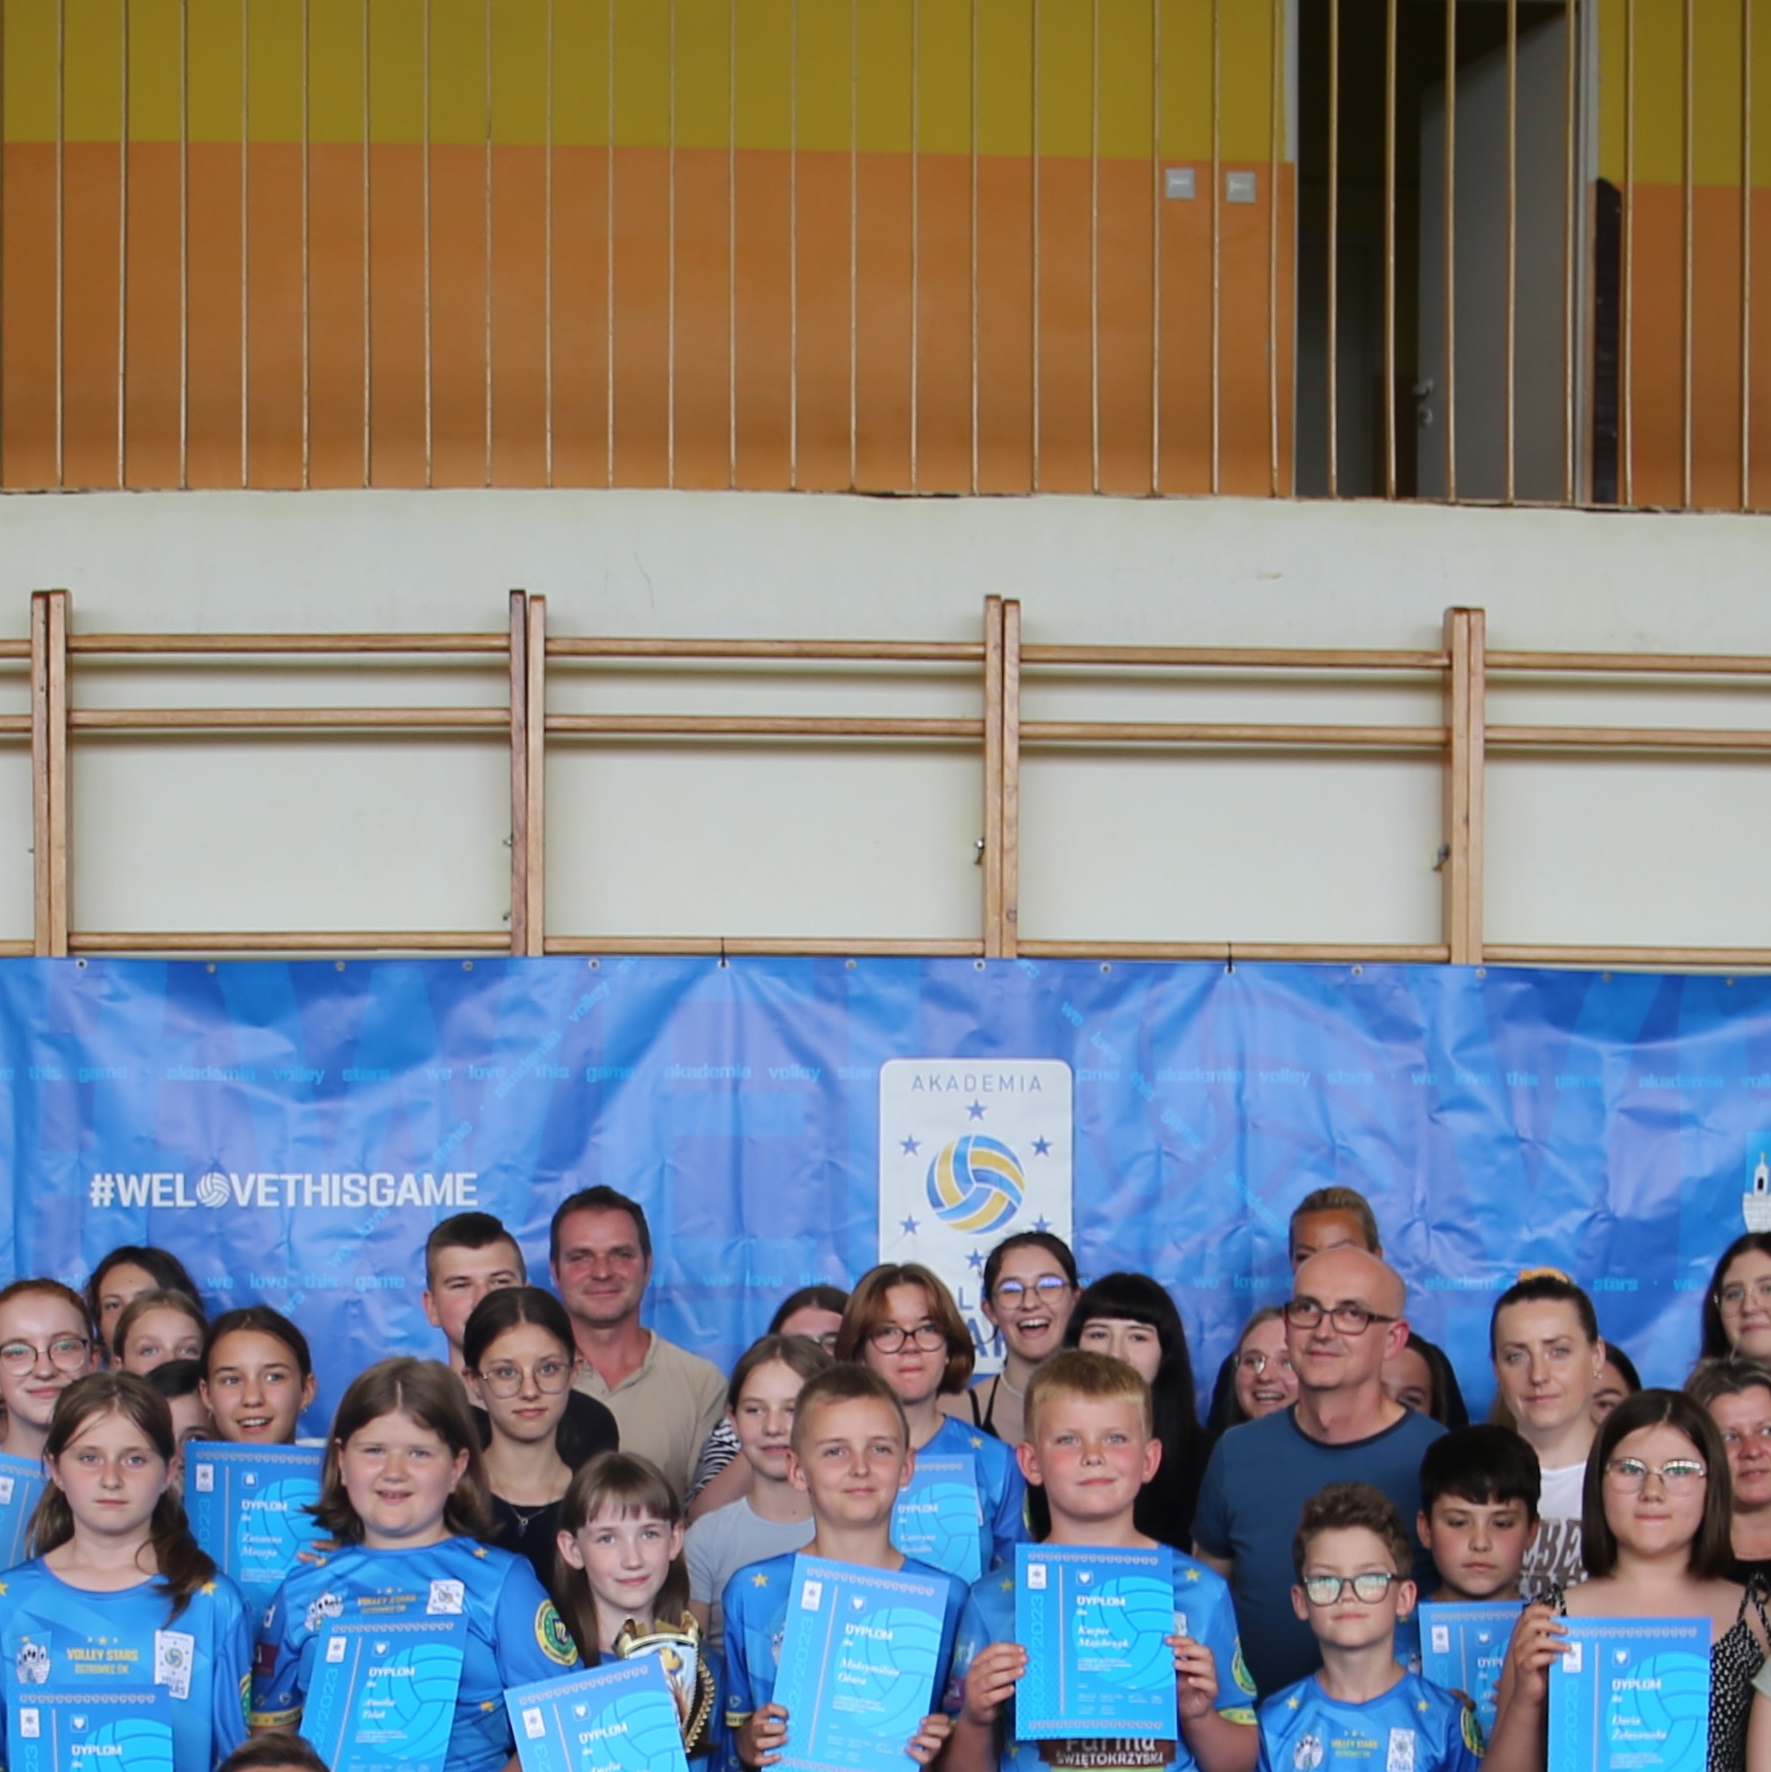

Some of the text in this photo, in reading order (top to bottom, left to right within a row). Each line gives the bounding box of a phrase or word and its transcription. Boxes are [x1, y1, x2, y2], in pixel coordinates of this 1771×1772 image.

[911, 1073, 1043, 1094] AKADEMIA
[240, 1500, 289, 1512] DYPLOM
[1076, 1595, 1126, 1607] DYPLOM
[844, 1622, 894, 1641] DYPLOM
[368, 1666, 416, 1678] DYPLOM
[1611, 1678, 1662, 1692] DYPLOM
[578, 1721, 629, 1744] DYPLOM
[71, 1744, 122, 1756] DYPLOM
[1056, 1750, 1164, 1768] ŚWIĘTOKRZYSKA
